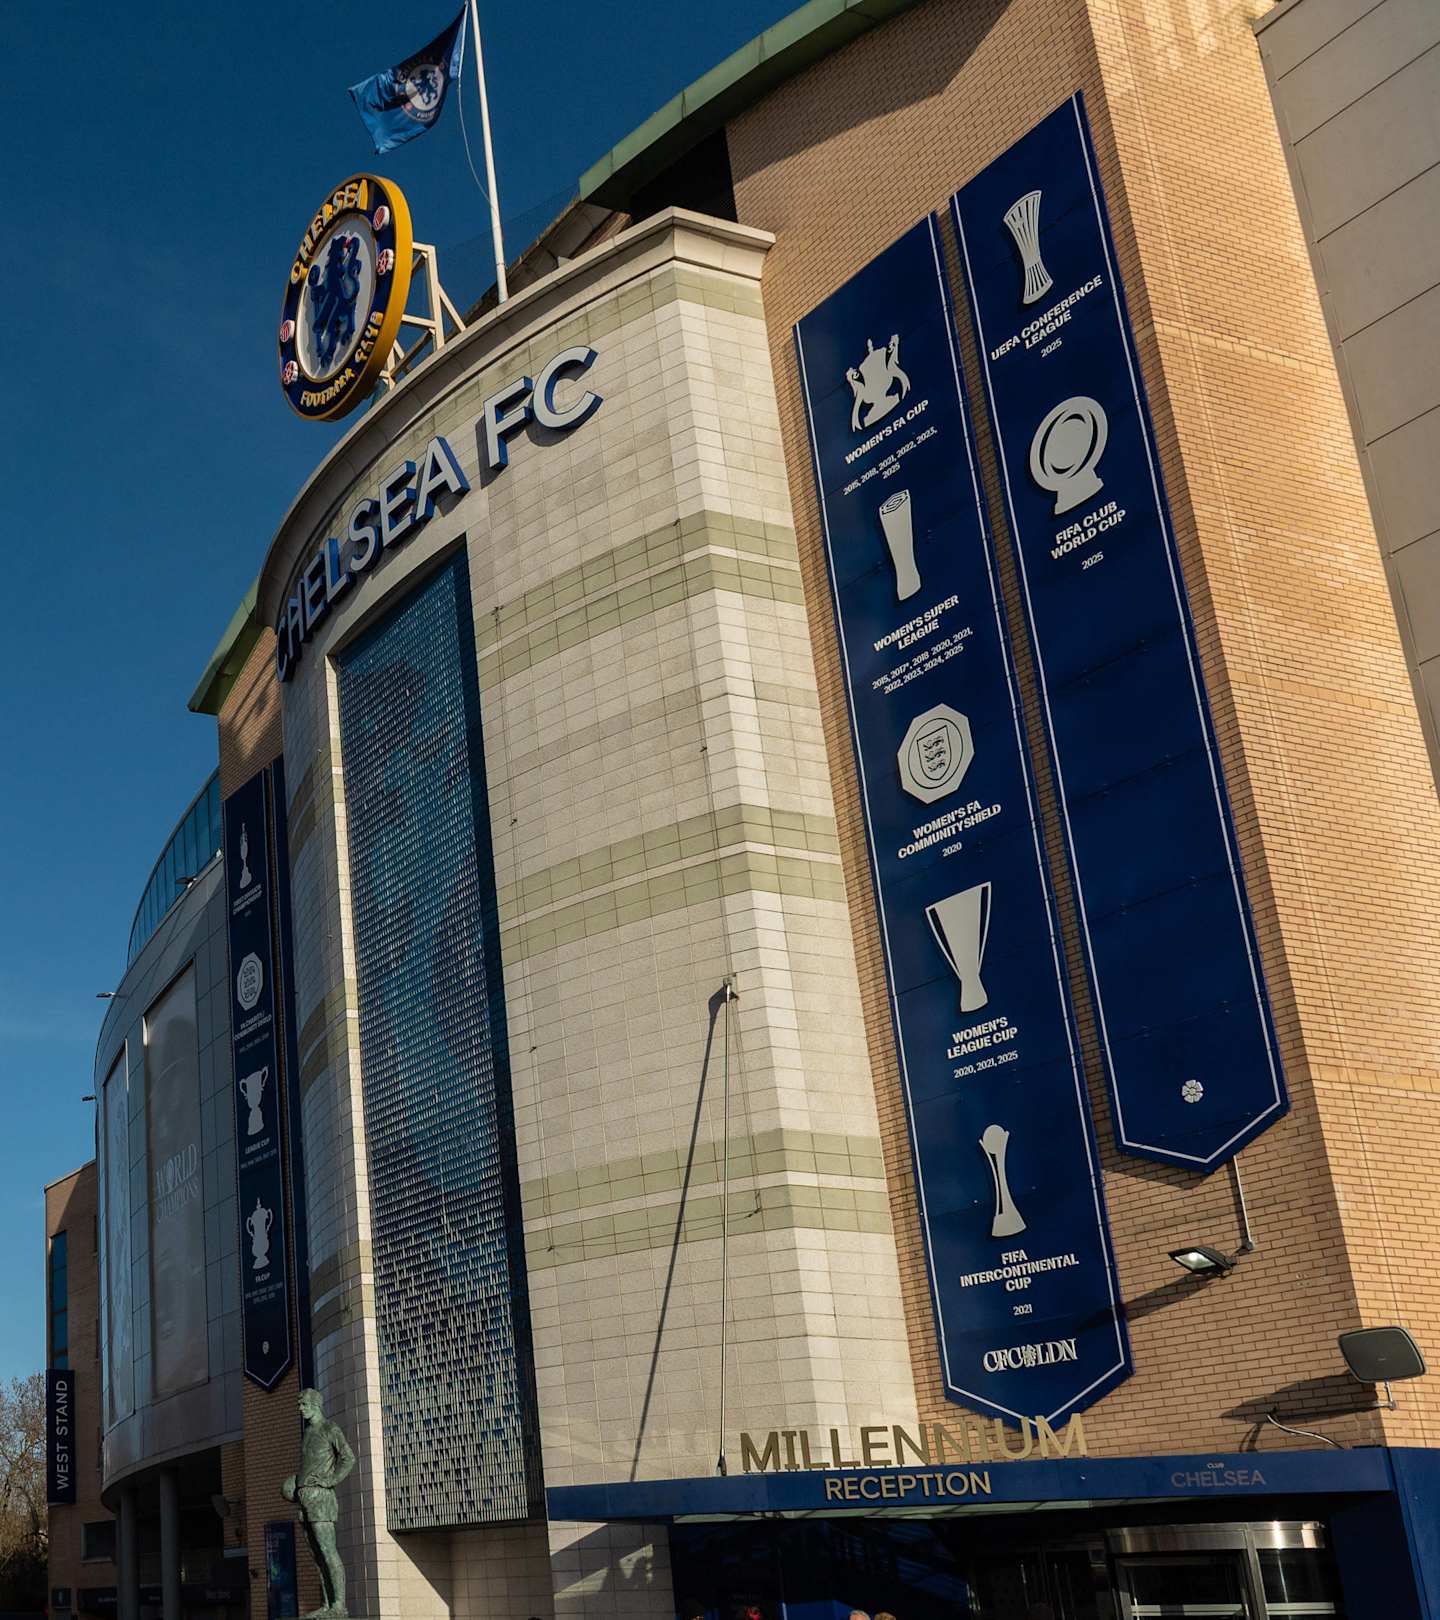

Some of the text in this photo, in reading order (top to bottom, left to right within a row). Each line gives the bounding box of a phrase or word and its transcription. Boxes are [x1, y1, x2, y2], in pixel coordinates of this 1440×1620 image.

[291, 178, 368, 284] CHELSEA
[991, 274, 1103, 360] UEFA CONFERENCE
[1025, 309, 1072, 350] LEAGUE
[1041, 337, 1063, 358] 2025
[845, 400, 929, 464] WOMEN'S FA CUP
[276, 345, 604, 682] CHELSEA FC
[1055, 501, 1118, 545] FIFA CLUB
[1050, 509, 1126, 560] WORLD CUP
[1081, 551, 1104, 570] 2025
[873, 595, 960, 652] WOMEN'S SUPER
[898, 619, 940, 650] LEAGUE
[944, 643, 964, 660] 2025
[898, 803, 1002, 859] COMMUNITY SHIELD
[913, 800, 982, 839] WOMEN'S FA
[942, 841, 963, 857] 2020
[947, 1027, 1018, 1059] LEAGUE CUP
[952, 1016, 1009, 1044] WOMEN'S
[953, 1050, 1019, 1079] 2020, 2021, 2025
[960, 1253, 1080, 1288] INTERCONTINENTAL
[1001, 1249, 1028, 1265] FIFA
[1005, 1277, 1032, 1292] CUP
[1013, 1304, 1033, 1316] 2021
[56, 1380, 69, 1490] WEST STAND
[740, 1413, 1088, 1471] MILLENNIUM
[825, 1471, 992, 1501] RECEPTION
[1170, 1469, 1267, 1488] CHELSEA
